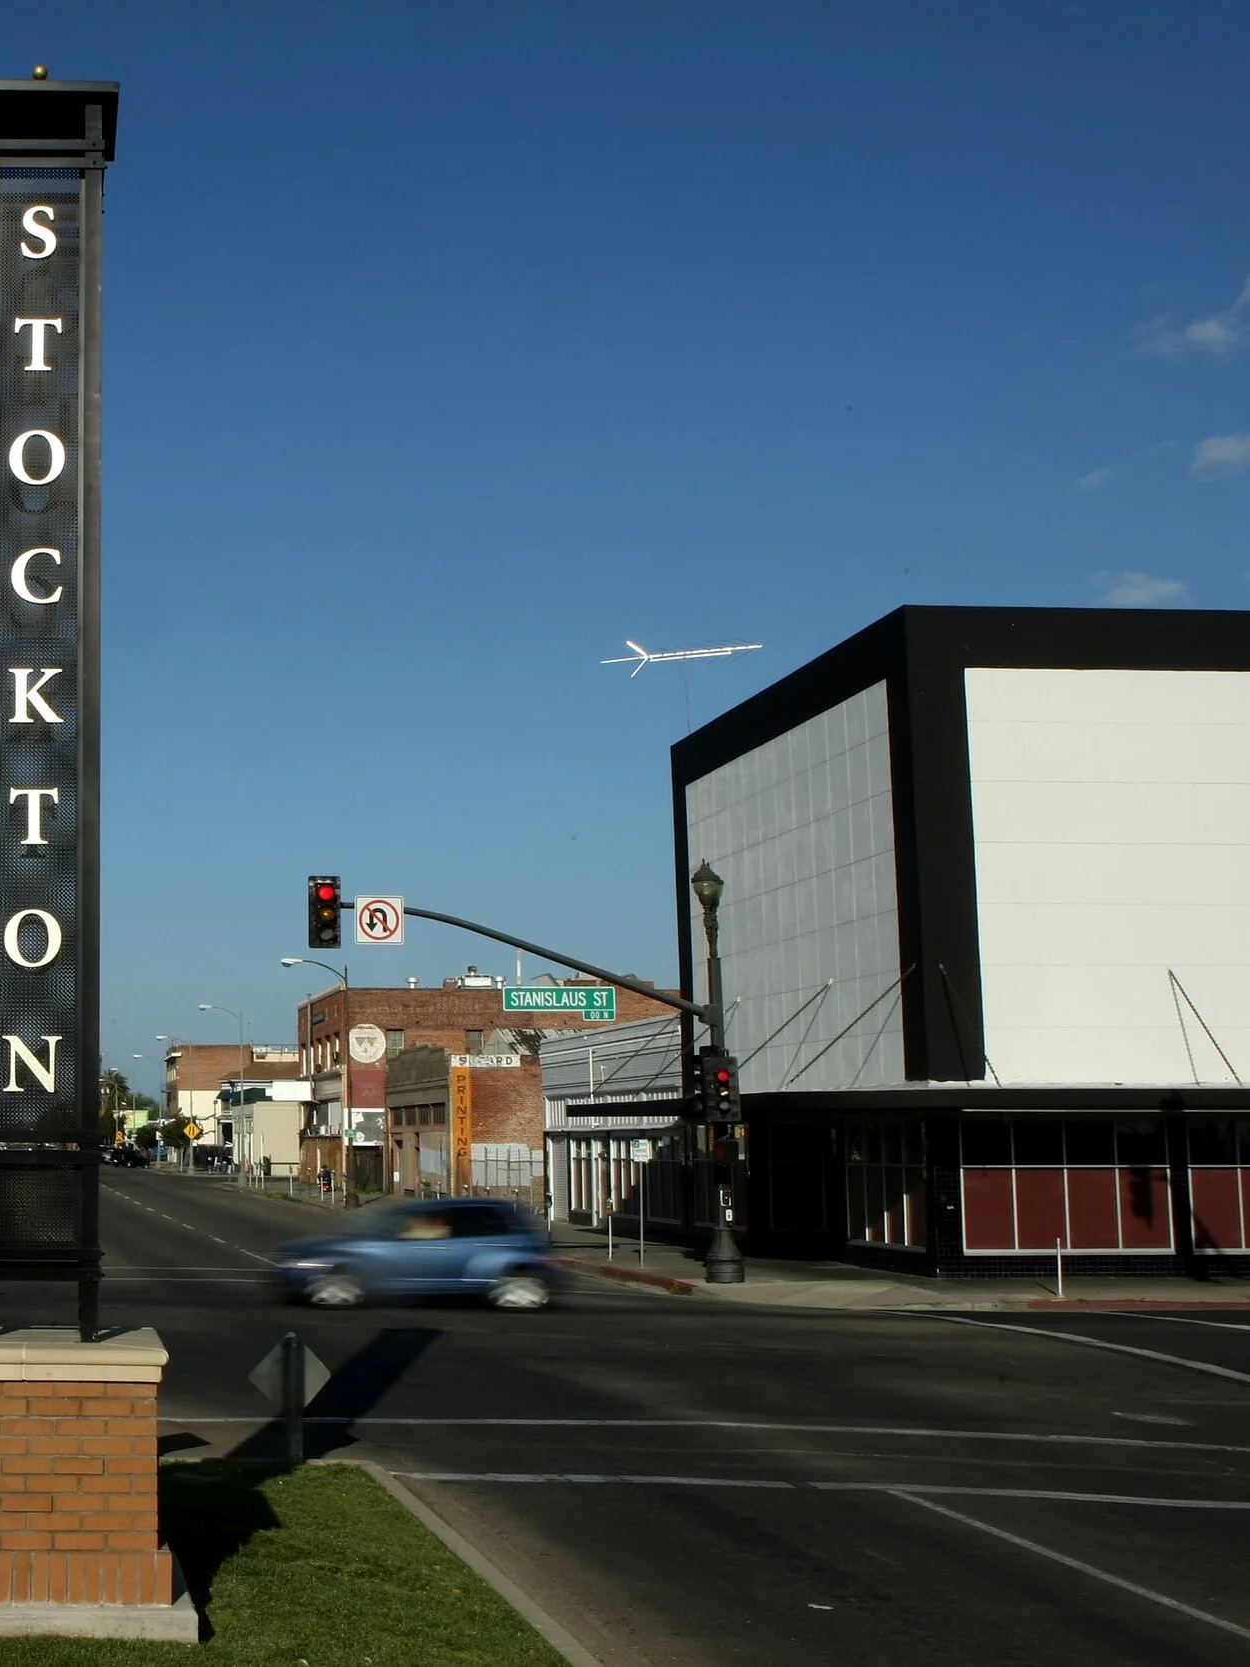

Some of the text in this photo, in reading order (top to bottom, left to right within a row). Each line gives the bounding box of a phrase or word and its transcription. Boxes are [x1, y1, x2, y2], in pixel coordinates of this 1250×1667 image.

[3, 205, 65, 1093] STOCKTON
[510, 991, 608, 1006] STANISLAUS ST
[456, 1075, 467, 1157] PRINTING
